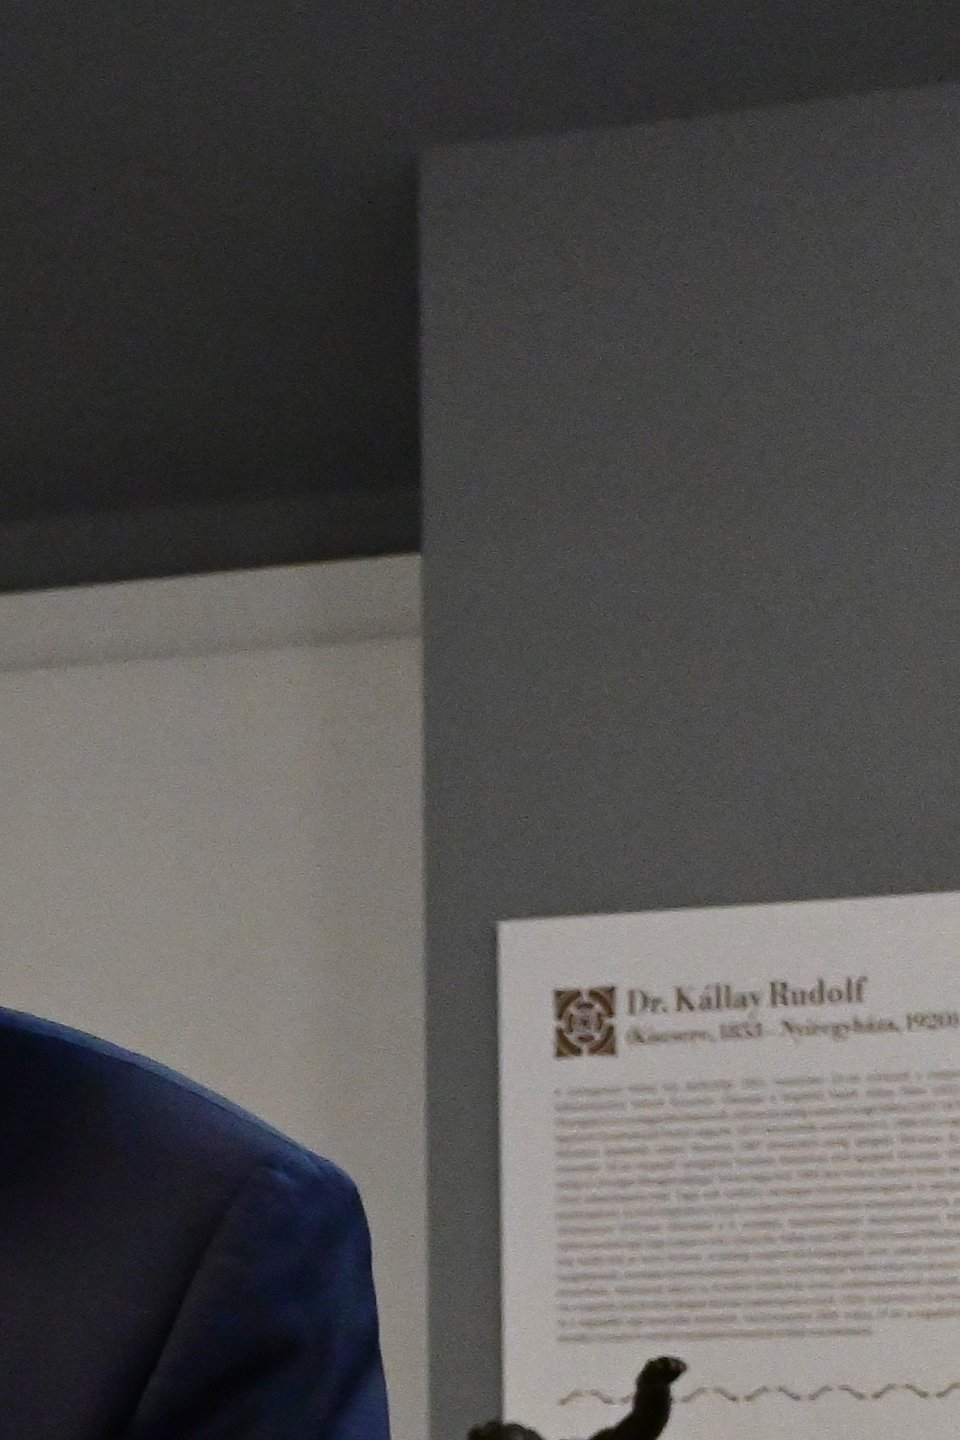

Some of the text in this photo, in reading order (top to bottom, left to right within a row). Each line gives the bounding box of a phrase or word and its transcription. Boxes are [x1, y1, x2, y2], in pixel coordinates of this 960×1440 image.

[626, 976, 868, 1019] Dr. Kállay Rudolf
